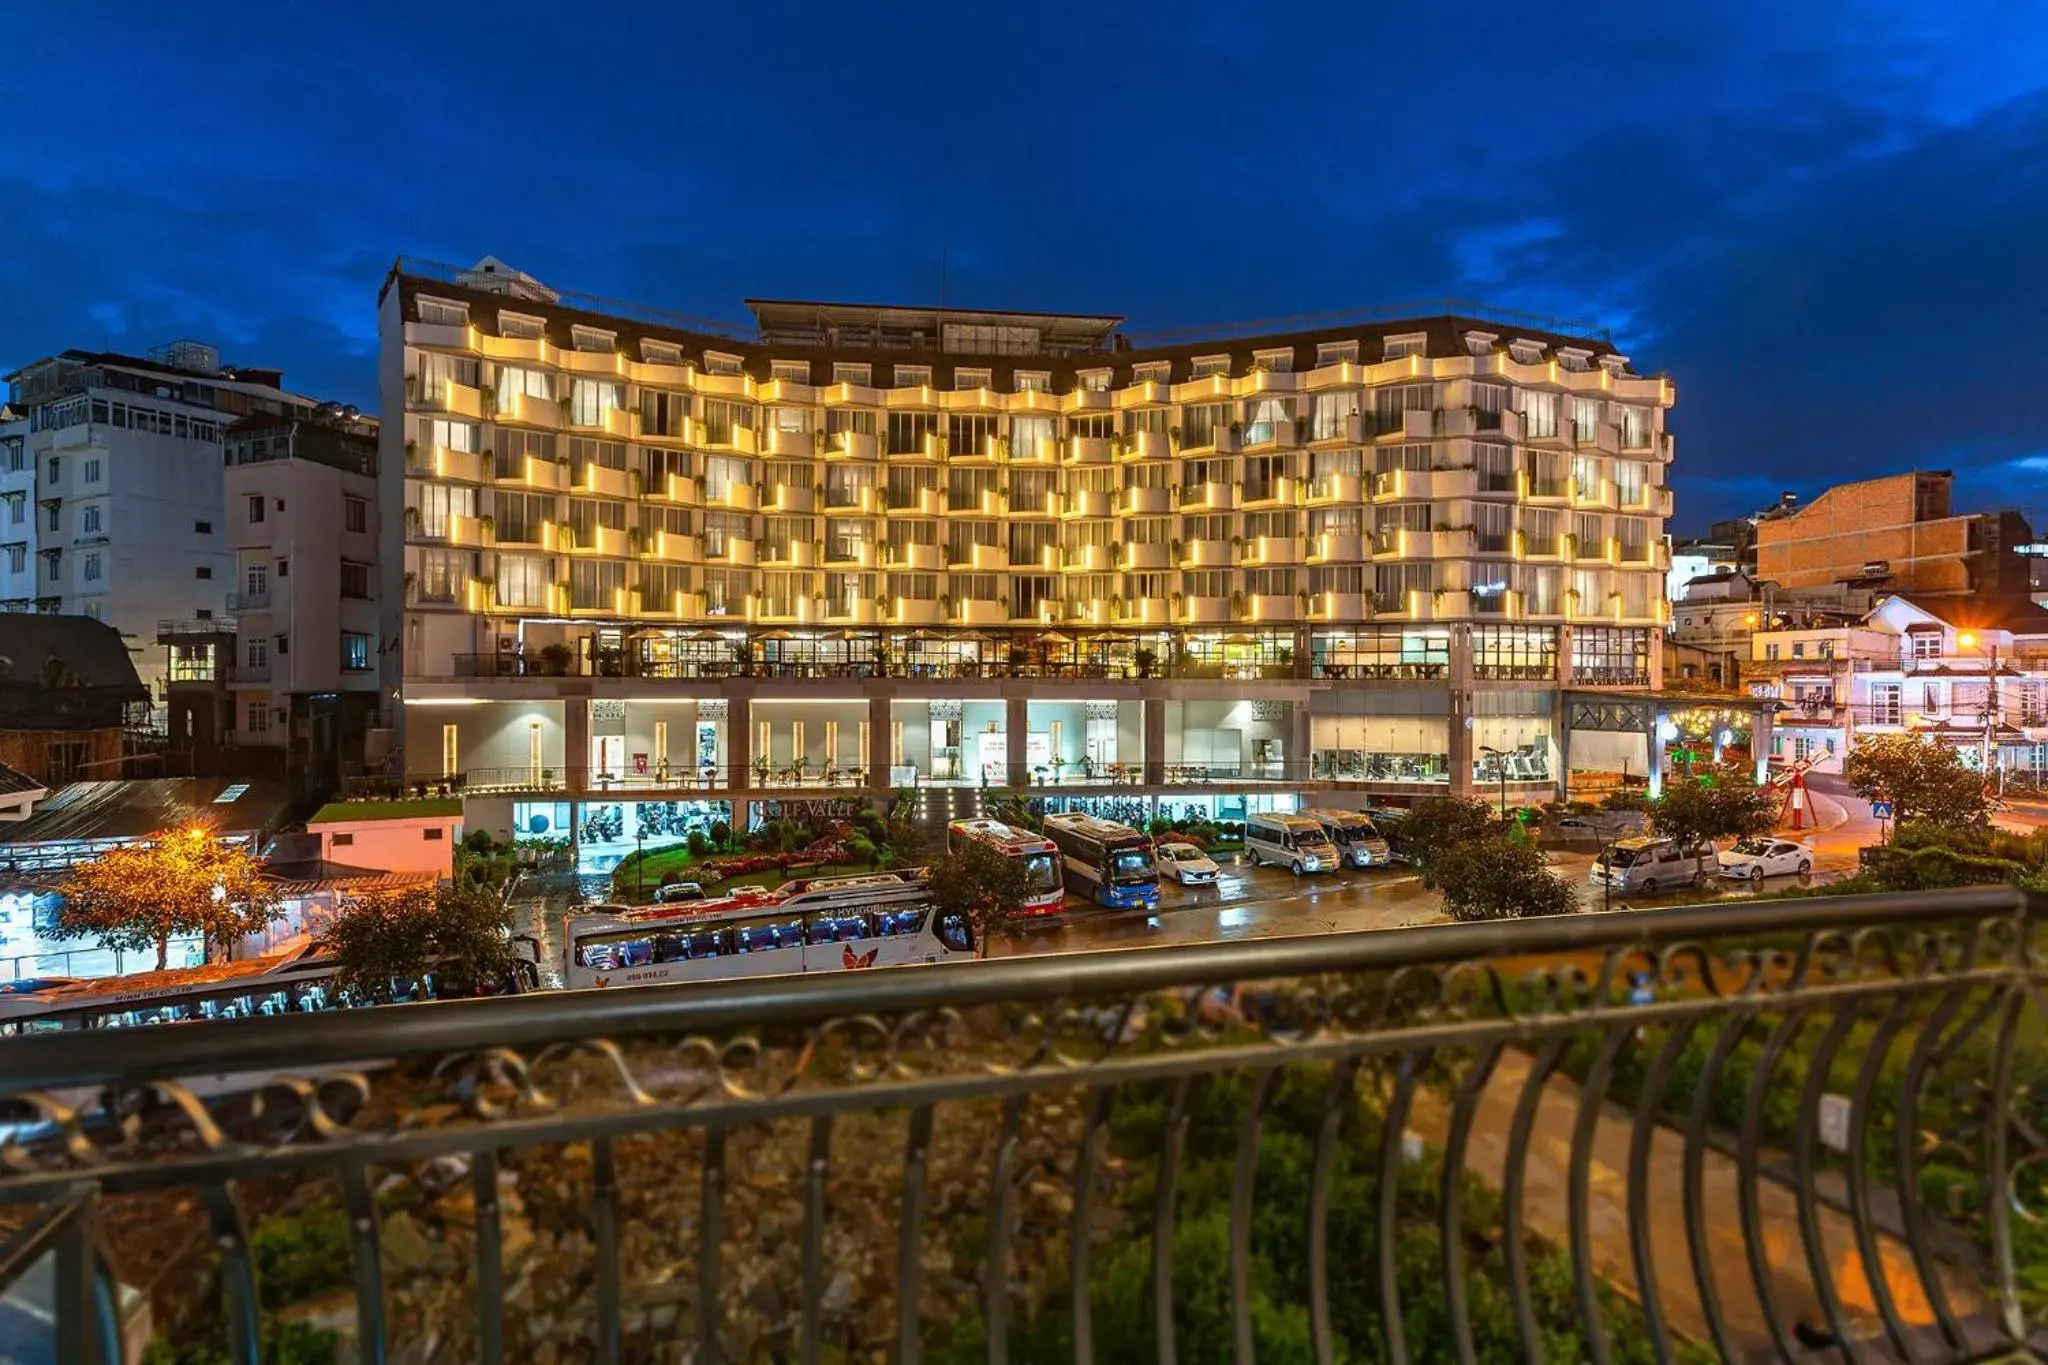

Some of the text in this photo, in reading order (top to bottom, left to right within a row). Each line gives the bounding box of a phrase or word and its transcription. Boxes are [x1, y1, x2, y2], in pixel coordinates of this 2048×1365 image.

[1577, 676, 1651, 686] VIVA STAR COFFEE
